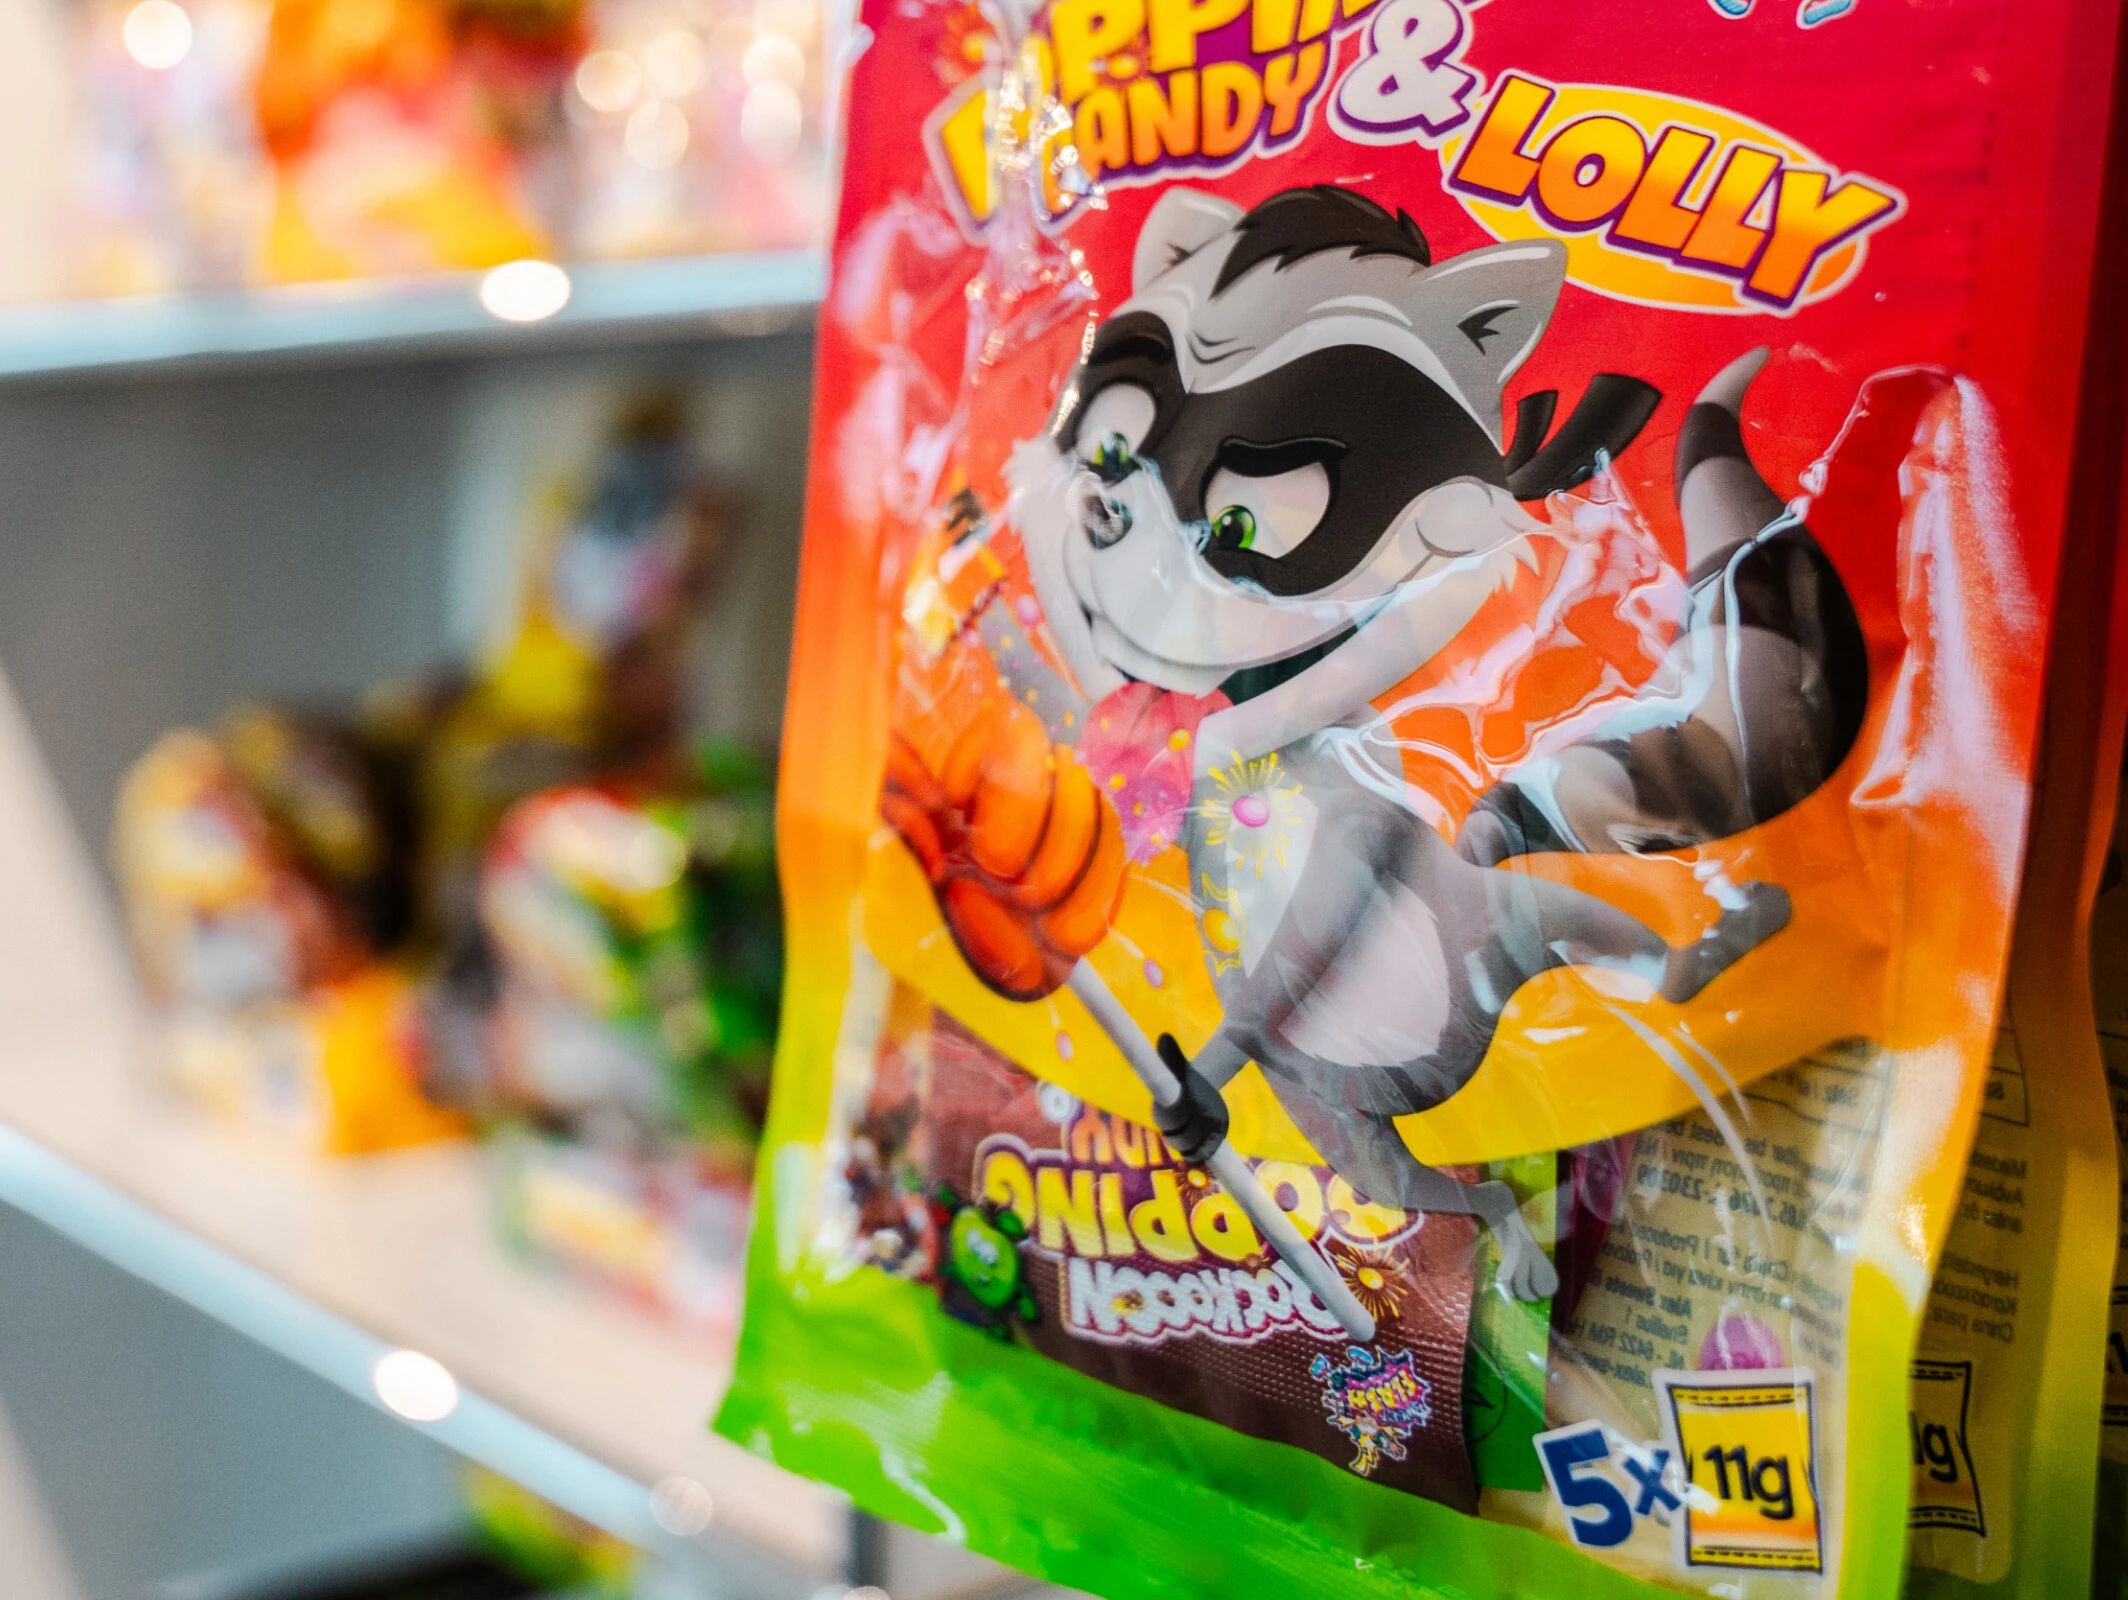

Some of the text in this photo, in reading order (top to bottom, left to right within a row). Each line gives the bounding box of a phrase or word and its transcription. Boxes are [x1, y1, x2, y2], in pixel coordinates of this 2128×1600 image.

[1334, 0, 1478, 138] &
[1449, 74, 1898, 310] LOLLY
[1703, 1443, 1796, 1521] 11g
